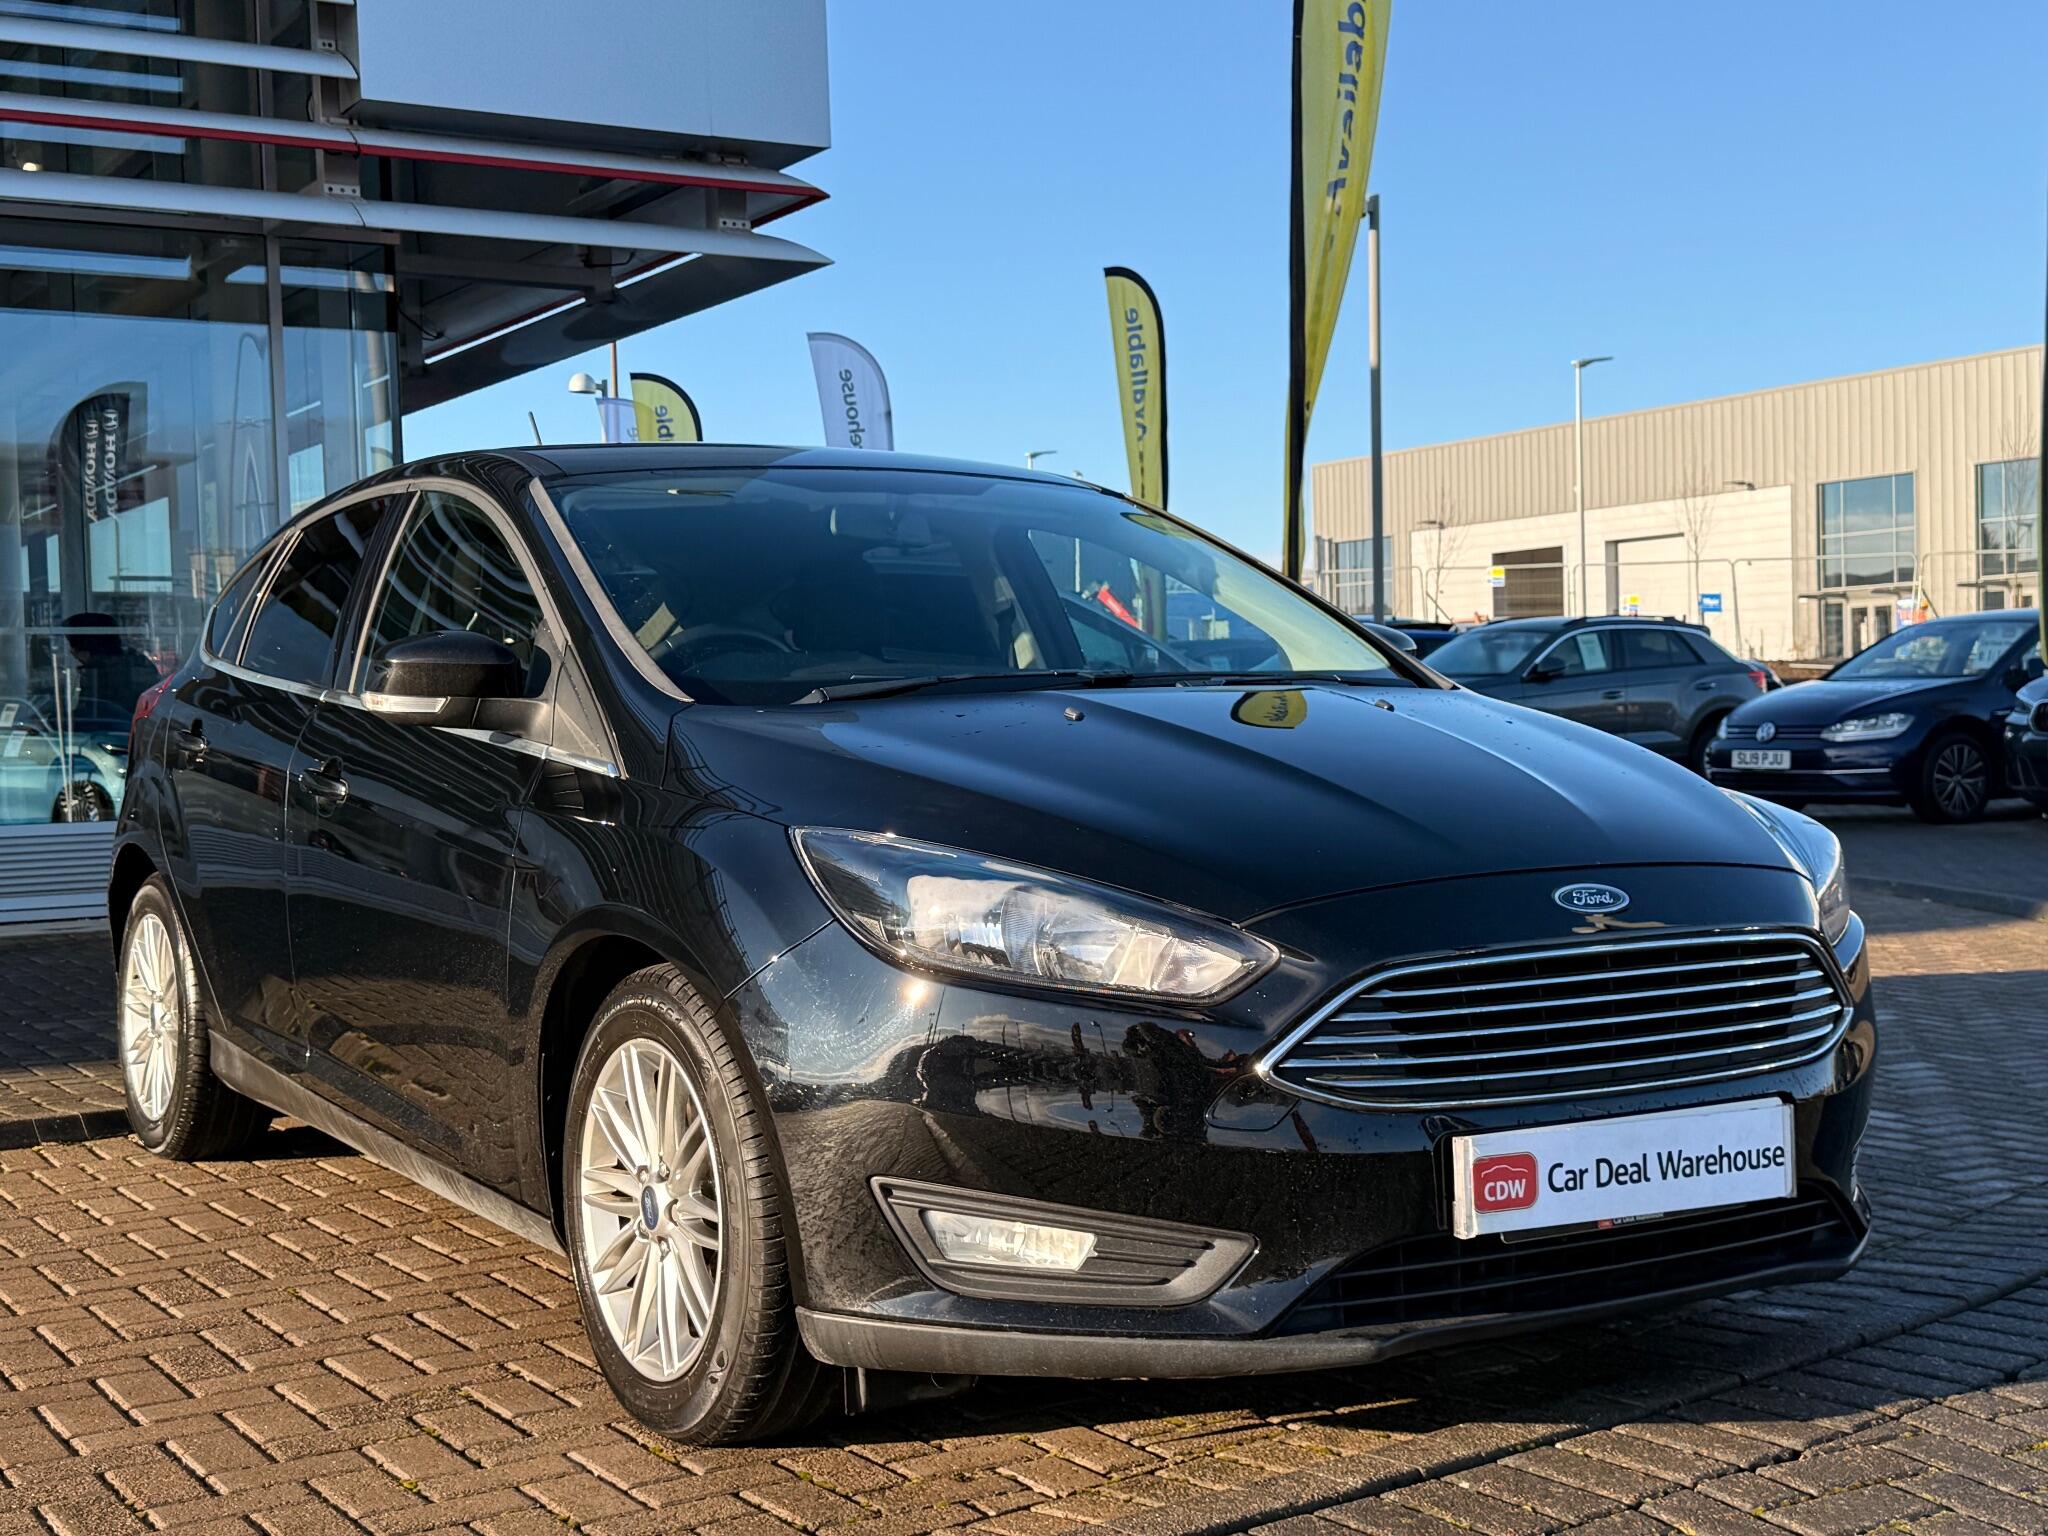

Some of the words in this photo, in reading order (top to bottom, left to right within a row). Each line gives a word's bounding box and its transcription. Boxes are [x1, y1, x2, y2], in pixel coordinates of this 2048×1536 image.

[1326, 0, 1367, 215] Availab
[1761, 751, 1784, 766] PJU
[1572, 889, 1614, 906] Ford
[1547, 1162, 1588, 1193] Car
[1595, 1153, 1651, 1189] Deal
[1656, 1144, 1786, 1179] Warehouse
[1483, 1178, 1527, 1202] CDW
